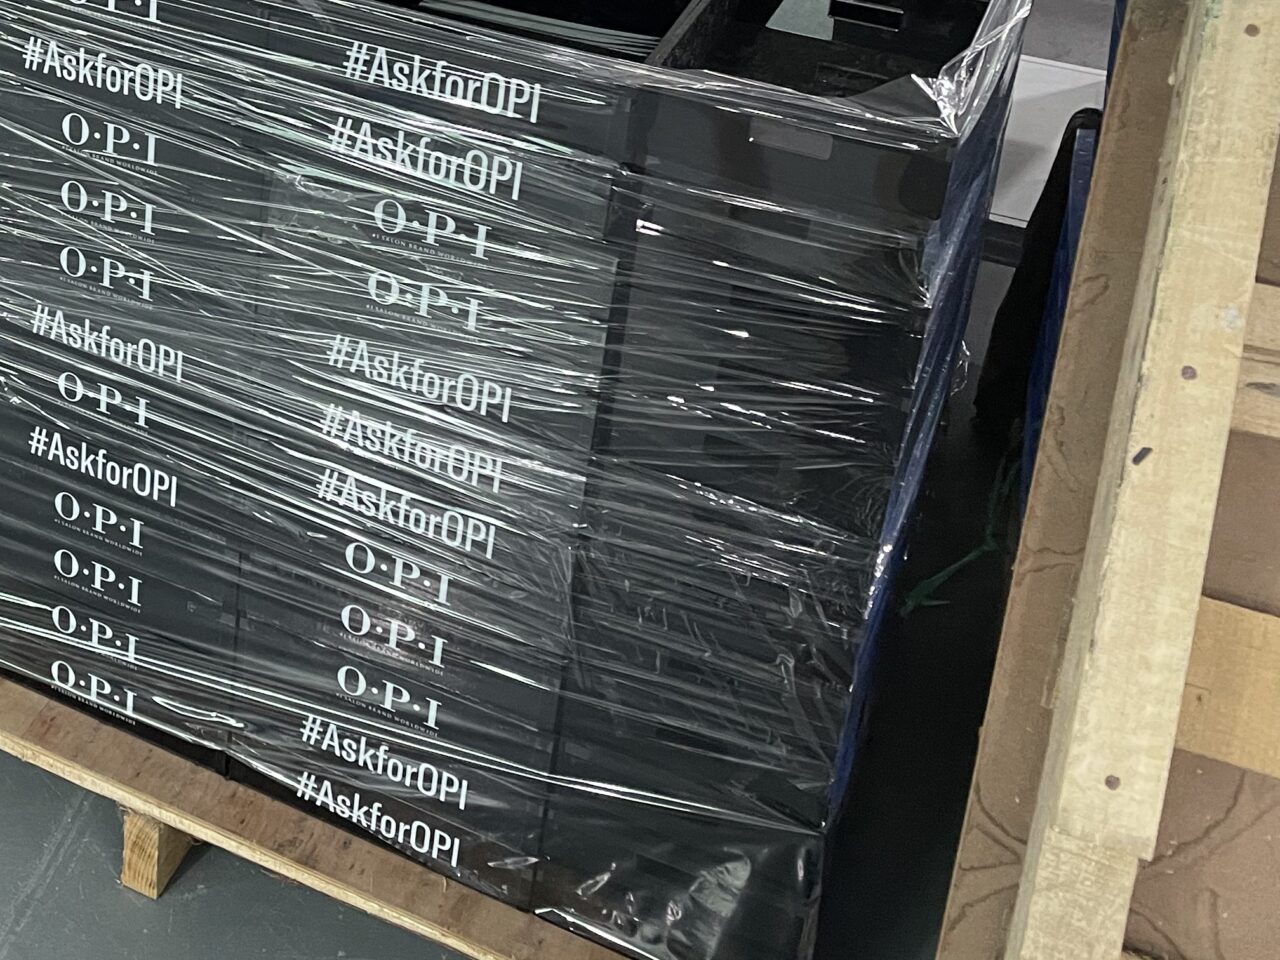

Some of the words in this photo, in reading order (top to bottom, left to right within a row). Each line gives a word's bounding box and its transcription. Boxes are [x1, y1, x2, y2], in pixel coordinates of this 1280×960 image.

[23, 36, 182, 109] #AskforOPI
[343, 41, 541, 124] #AskforOPI
[61, 113, 160, 166] O·P·I
[328, 117, 524, 200] #AskforOPI
[60, 180, 157, 236] O·P·I
[373, 199, 492, 260] O·P·I
[59, 246, 154, 302] O·P·I
[381, 235, 405, 246] SALON
[408, 243, 435, 254] BRAND
[32, 304, 182, 383] #AskforOPI
[58, 372, 150, 429] O·P·I
[327, 334, 512, 423] #AskforOPI
[28, 426, 178, 507] #AskforOPI
[54, 491, 144, 549] O·P·I
[317, 469, 496, 560] #AskforOPI
[54, 549, 143, 606] O·P·I
[345, 542, 451, 606] O·P·I
[52, 605, 139, 663] O·P·I
[341, 604, 448, 669] O·P·I
[51, 660, 138, 715] O·P·I
[337, 665, 442, 730] O·P·I
[300, 715, 468, 811] #AskforOPI
[296, 772, 460, 868] #AskforOPI
